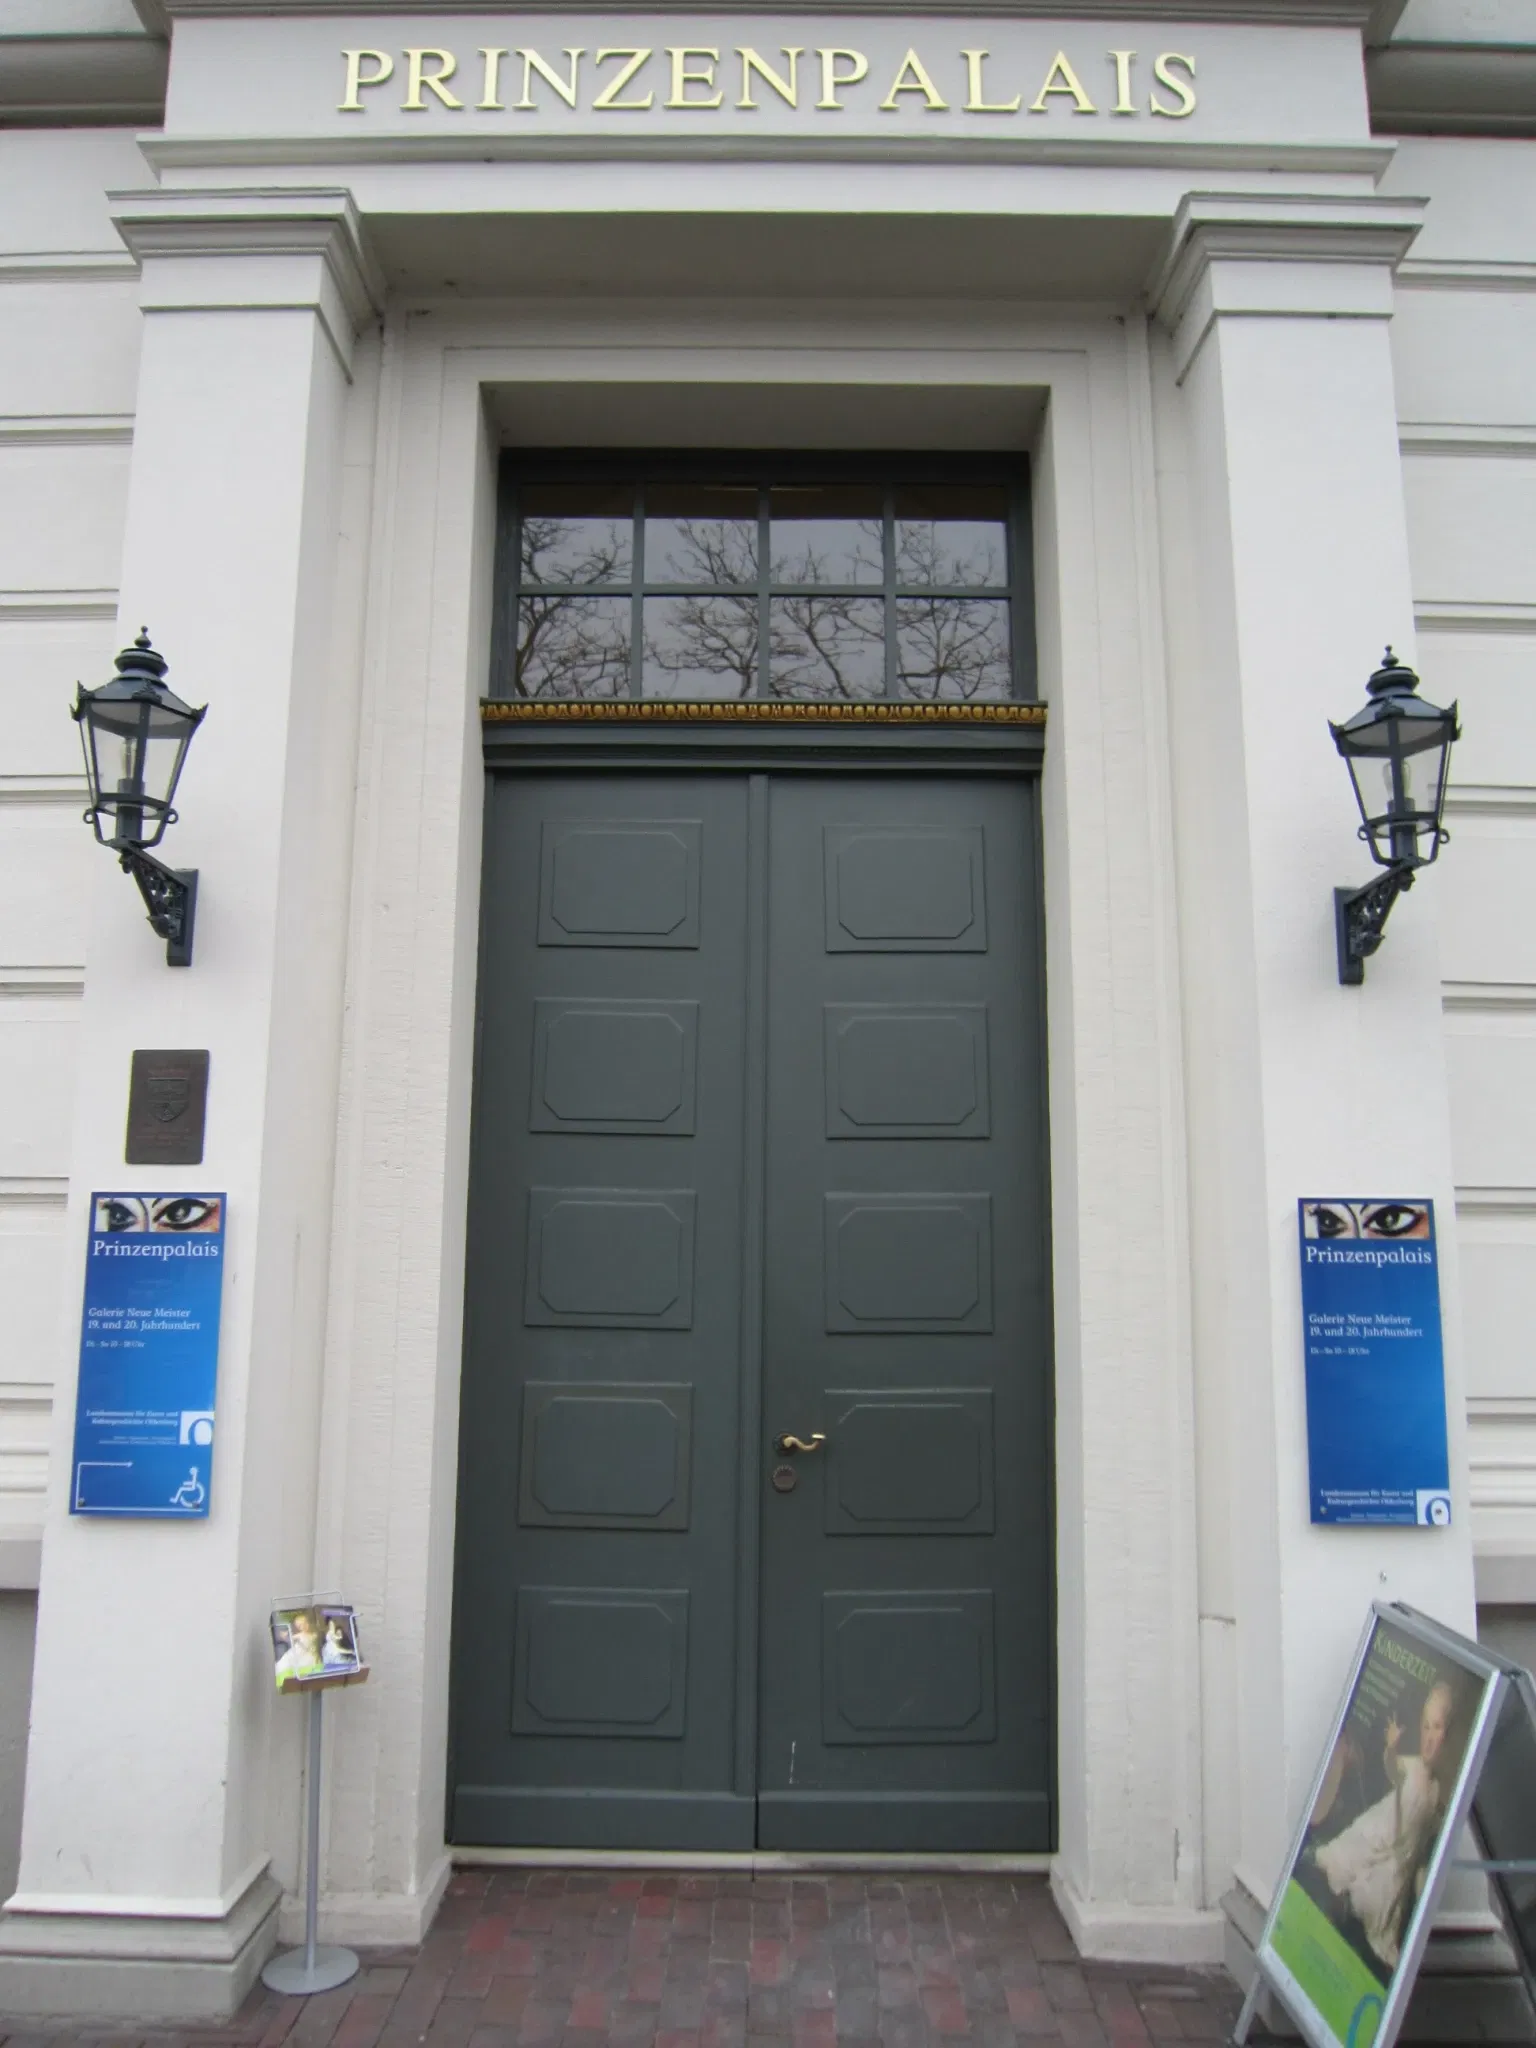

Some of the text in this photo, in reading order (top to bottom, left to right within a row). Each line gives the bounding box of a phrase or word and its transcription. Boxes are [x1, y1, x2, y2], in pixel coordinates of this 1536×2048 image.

[335, 47, 1197, 118] PRINZENPALAIS
[92, 1240, 219, 1261] Prinzenpalais
[1305, 1245, 1432, 1268] Prinzenpalais
[88, 1307, 191, 1317] Galerie Neue Meister
[1309, 1314, 1412, 1325] Galerie Neue Meister
[88, 1319, 201, 1332] 19. und 20. Jahrhundert
[1310, 1326, 1423, 1339] 19. und 20. Jahrhundert
[1373, 1628, 1437, 1686] KINDERZEIT
